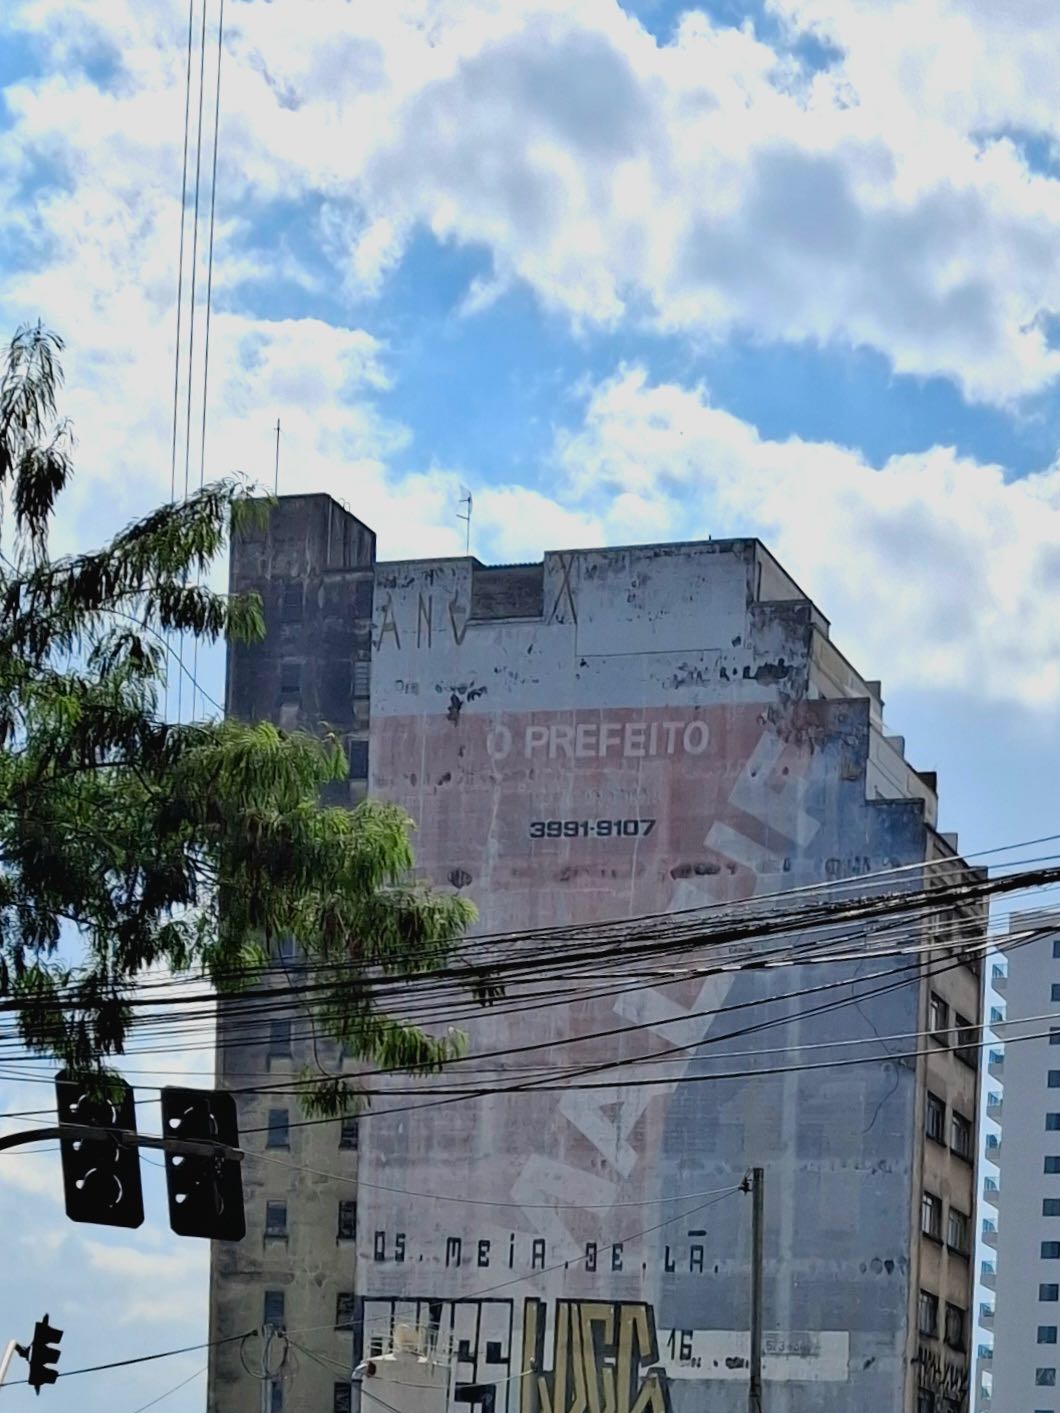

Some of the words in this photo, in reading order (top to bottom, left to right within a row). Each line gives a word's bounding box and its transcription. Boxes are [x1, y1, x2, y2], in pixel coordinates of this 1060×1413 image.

[487, 727, 513, 760] O
[524, 720, 711, 759] PREFEITO
[529, 819, 656, 839] 3991-9107
